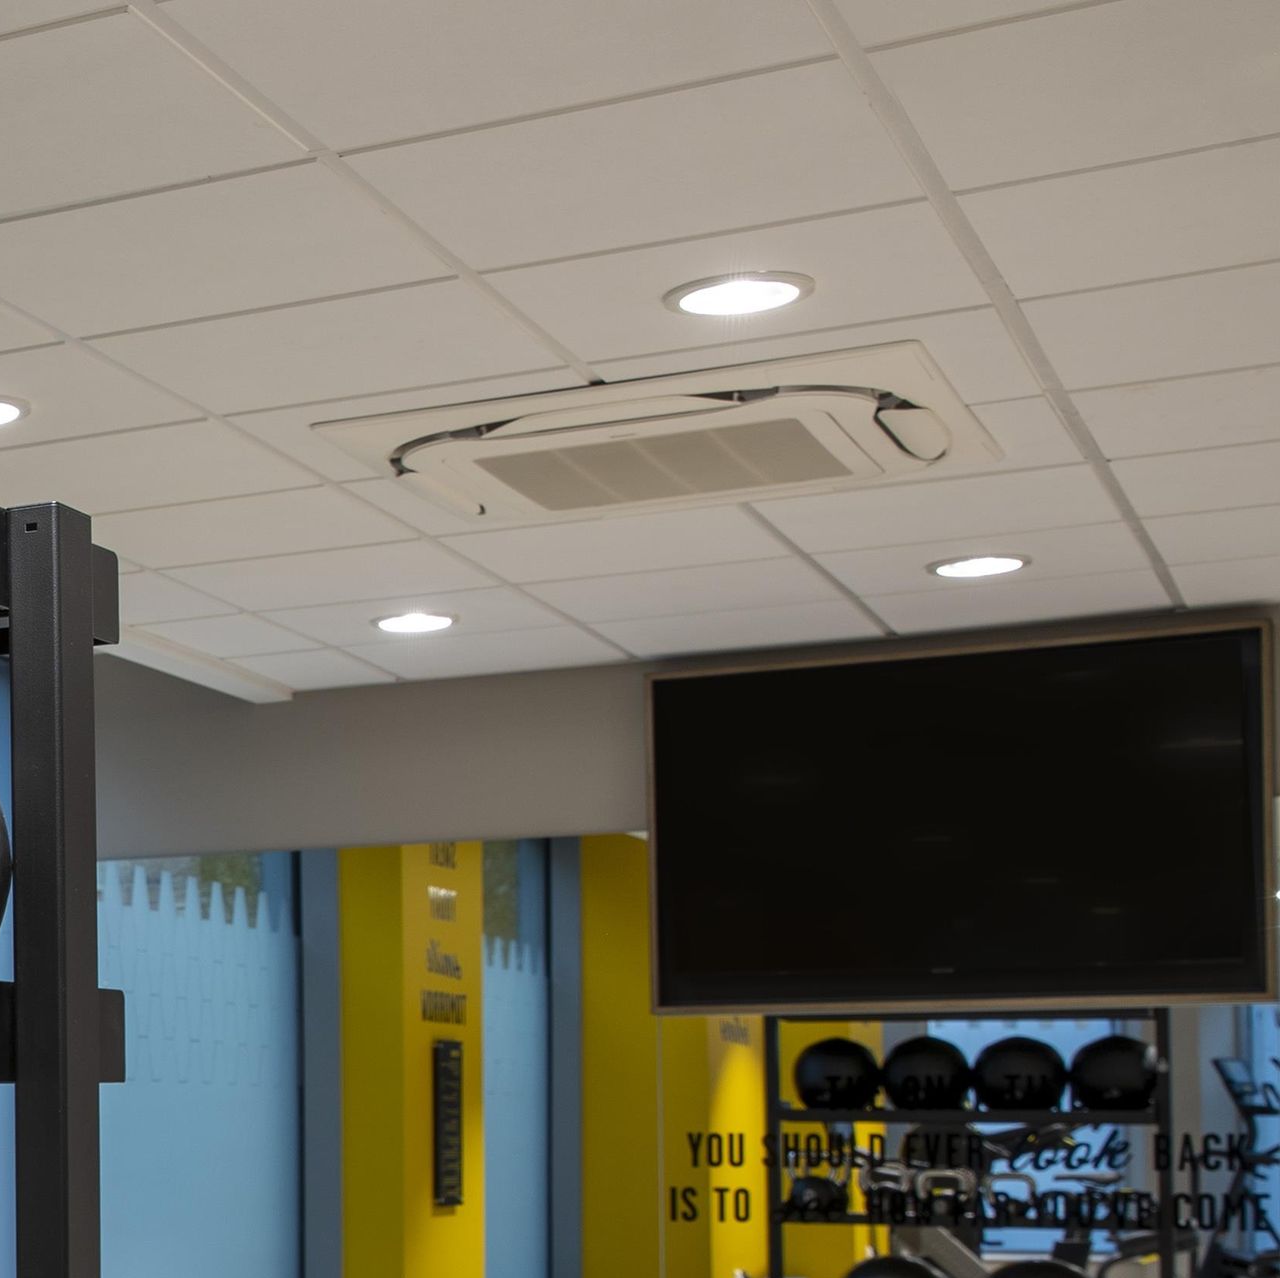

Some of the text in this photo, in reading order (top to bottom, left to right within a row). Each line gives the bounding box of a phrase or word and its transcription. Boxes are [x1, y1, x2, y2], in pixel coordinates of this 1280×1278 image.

[686, 1132, 745, 1168] YOU
[906, 1134, 984, 1170] EVER
[1153, 1133, 1249, 1171] BACK
[670, 1187, 700, 1222] IS
[713, 1187, 750, 1223] TO
[1173, 1193, 1271, 1231] COME
